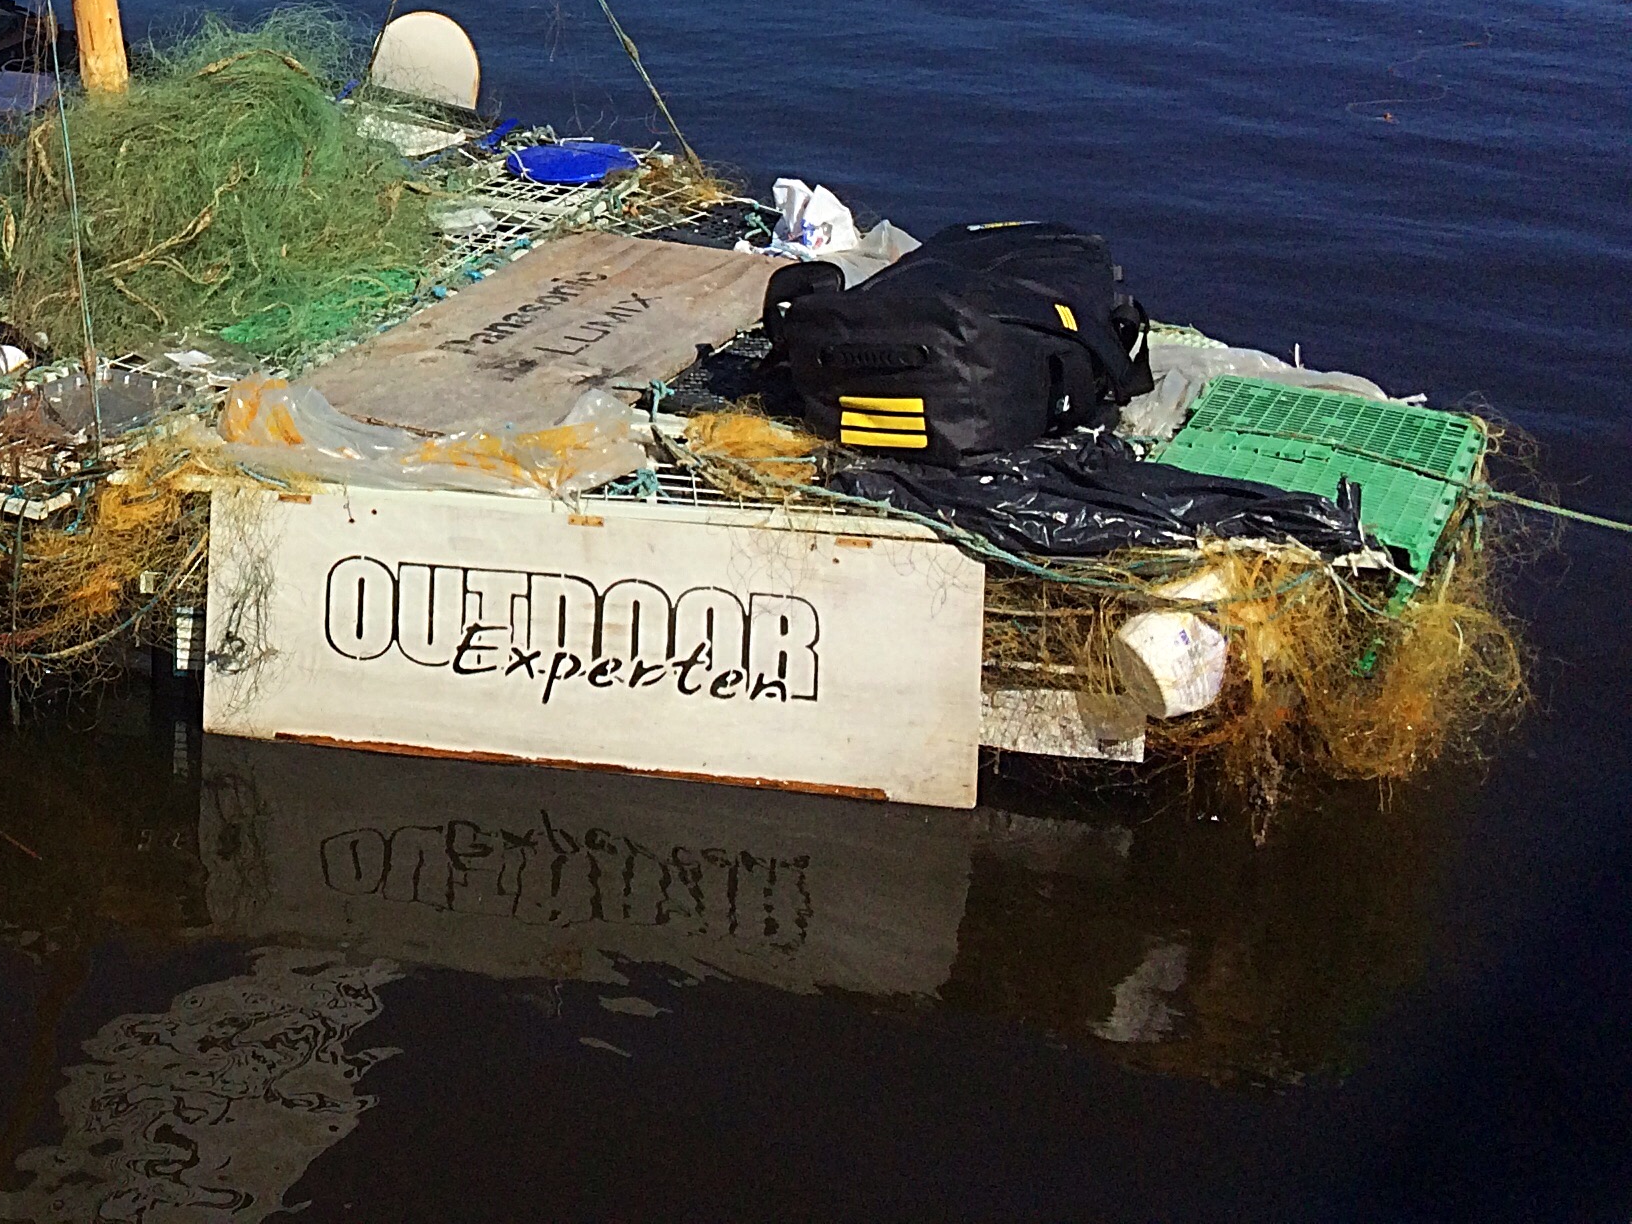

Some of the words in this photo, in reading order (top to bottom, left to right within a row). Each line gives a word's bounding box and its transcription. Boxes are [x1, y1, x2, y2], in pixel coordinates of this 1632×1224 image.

[435, 271, 608, 356] Panasonic
[533, 292, 663, 356] LUMIX
[325, 555, 821, 702] OUTDOOR
[451, 624, 788, 704] Experten
